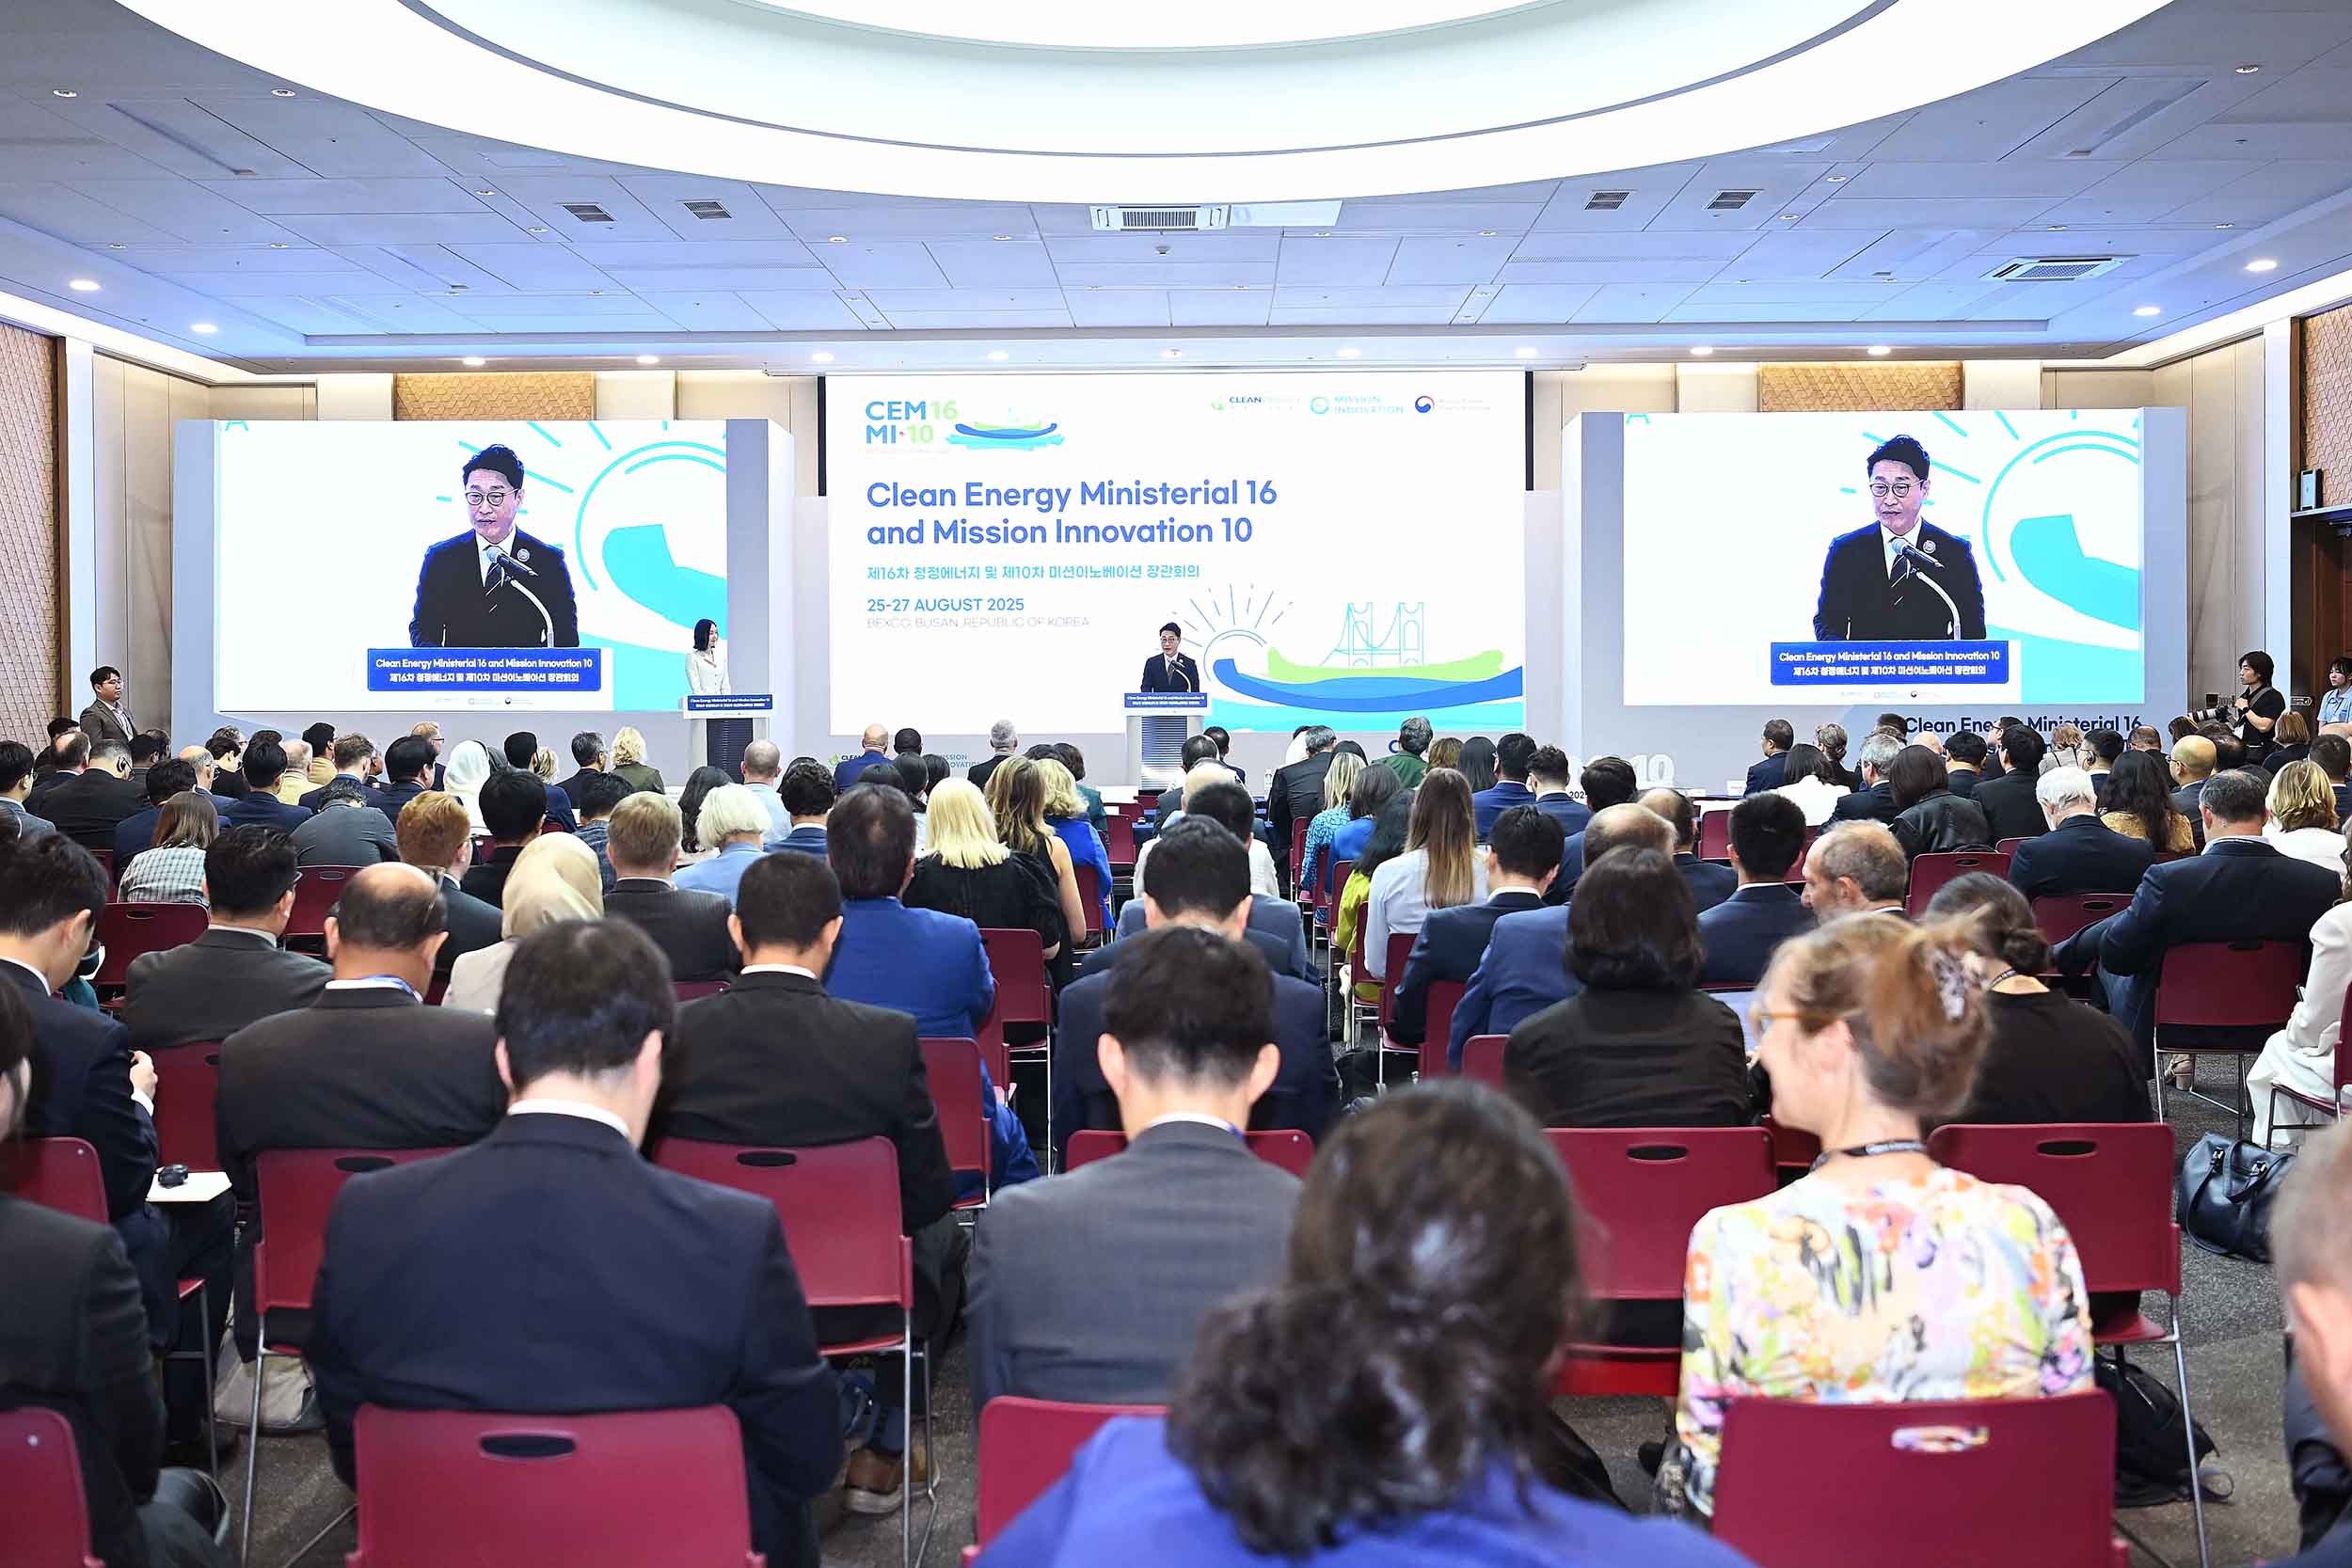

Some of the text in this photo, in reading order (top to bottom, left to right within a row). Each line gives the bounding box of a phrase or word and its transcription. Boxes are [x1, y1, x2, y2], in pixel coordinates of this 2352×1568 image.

[866, 479, 1278, 514] Clean Energy Ministerial 16
[866, 516, 1253, 546] and Mission Innovation 10
[867, 565, 911, 580] 제16차
[1002, 565, 1045, 579] 제10차
[1048, 564, 1142, 579] 미션이노베이션
[1147, 564, 1200, 579] 장관회의
[866, 597, 1025, 612] 25-27 AUGUST 2025
[375, 657, 593, 671] Clean Energy Ministerial 16 and Mission Innovation 10
[1779, 650, 2000, 664] Clean Energy Ministerial 16 and Mission Innovation 10
[1904, 716, 2143, 733] Clean Ene Miniterial 16
[1568, 790, 1587, 800] 202
